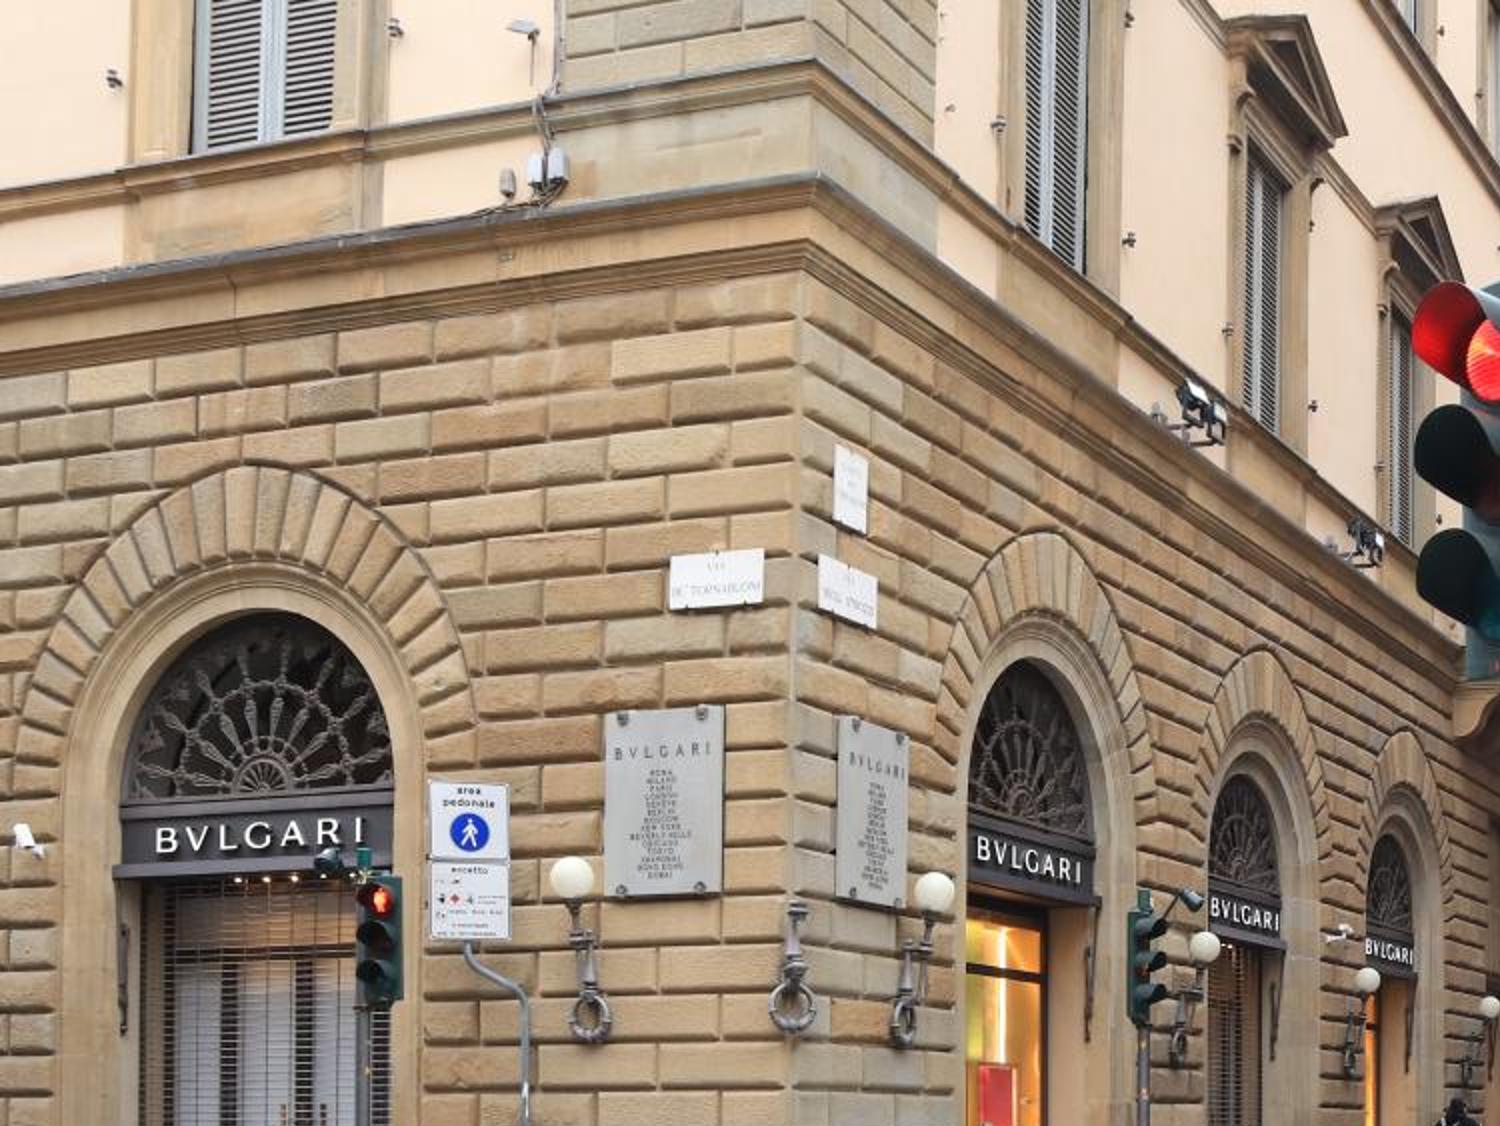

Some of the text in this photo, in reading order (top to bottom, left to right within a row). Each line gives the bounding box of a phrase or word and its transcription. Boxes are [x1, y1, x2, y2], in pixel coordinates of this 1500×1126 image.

[614, 741, 711, 761] BVLGARI
[442, 798, 496, 809] pedonale
[456, 786, 482, 795] area
[155, 816, 364, 854] BVLGARI
[977, 835, 1081, 884] BVLGARI
[1210, 896, 1280, 932] BVLGARI
[1365, 937, 1413, 966] BVLGARI
